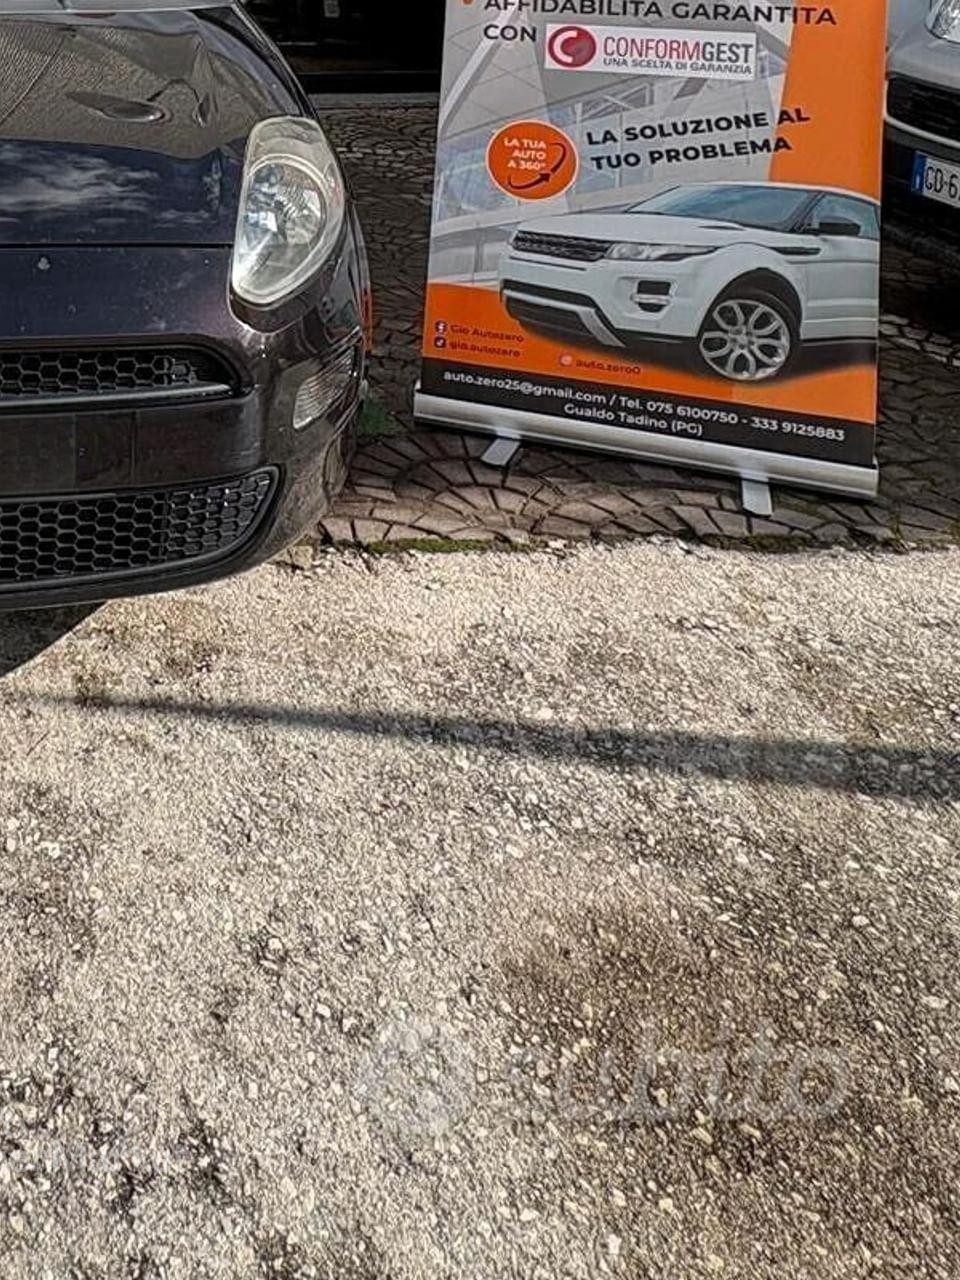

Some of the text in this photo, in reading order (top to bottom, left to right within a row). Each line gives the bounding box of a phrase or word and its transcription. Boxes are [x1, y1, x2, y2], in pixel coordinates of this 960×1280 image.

[671, 2, 837, 26] GARANTITA
[484, 24, 537, 43] CON
[603, 36, 754, 64] CONFORMGEST
[603, 58, 752, 75] UNA SCELTA DI GARANZIA
[586, 107, 811, 146] LA SOLUZIONE AL
[503, 137, 546, 149] LA TUA
[512, 149, 546, 160] AUTO
[591, 136, 792, 171] TUO PROBLEMA
[507, 160, 516, 168] A
[444, 371, 606, 404] auto.zero25@gmail.com
[619, 396, 644, 410] Tel.
[647, 401, 673, 414] 075
[676, 405, 739, 424] 6100750
[750, 416, 778, 431] 333
[564, 403, 703, 436] Gualdo Tadino (PG)
